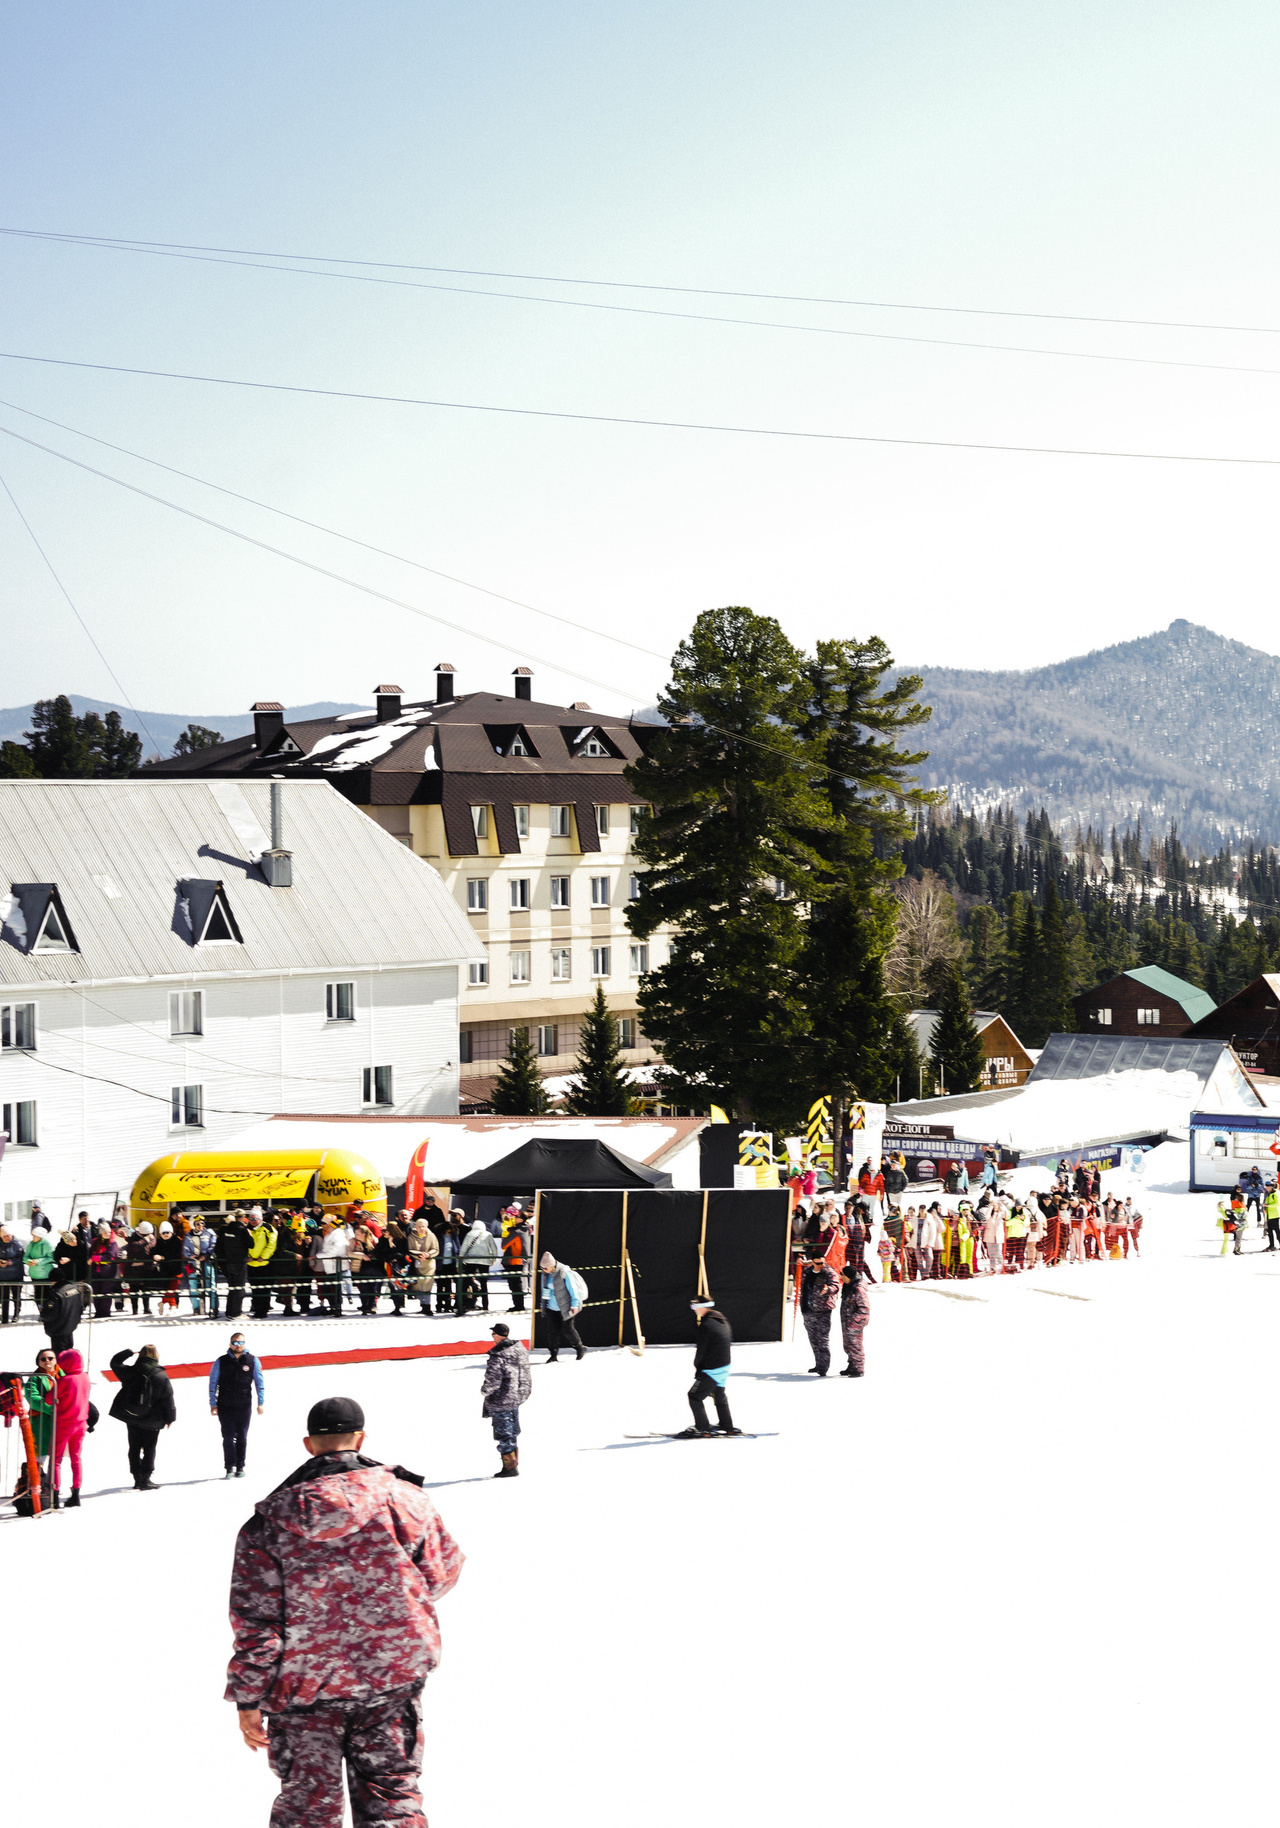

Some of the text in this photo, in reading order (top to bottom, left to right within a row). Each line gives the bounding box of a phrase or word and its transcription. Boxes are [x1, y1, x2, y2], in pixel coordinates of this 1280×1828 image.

[882, 1138, 976, 1154] АЗИН СПОРТИВНОЙ ОДЕЖДЫ
[1088, 1147, 1118, 1160] МАГАЗИН
[322, 1178, 347, 1188] YUM
[324, 1187, 349, 1197] YUM
